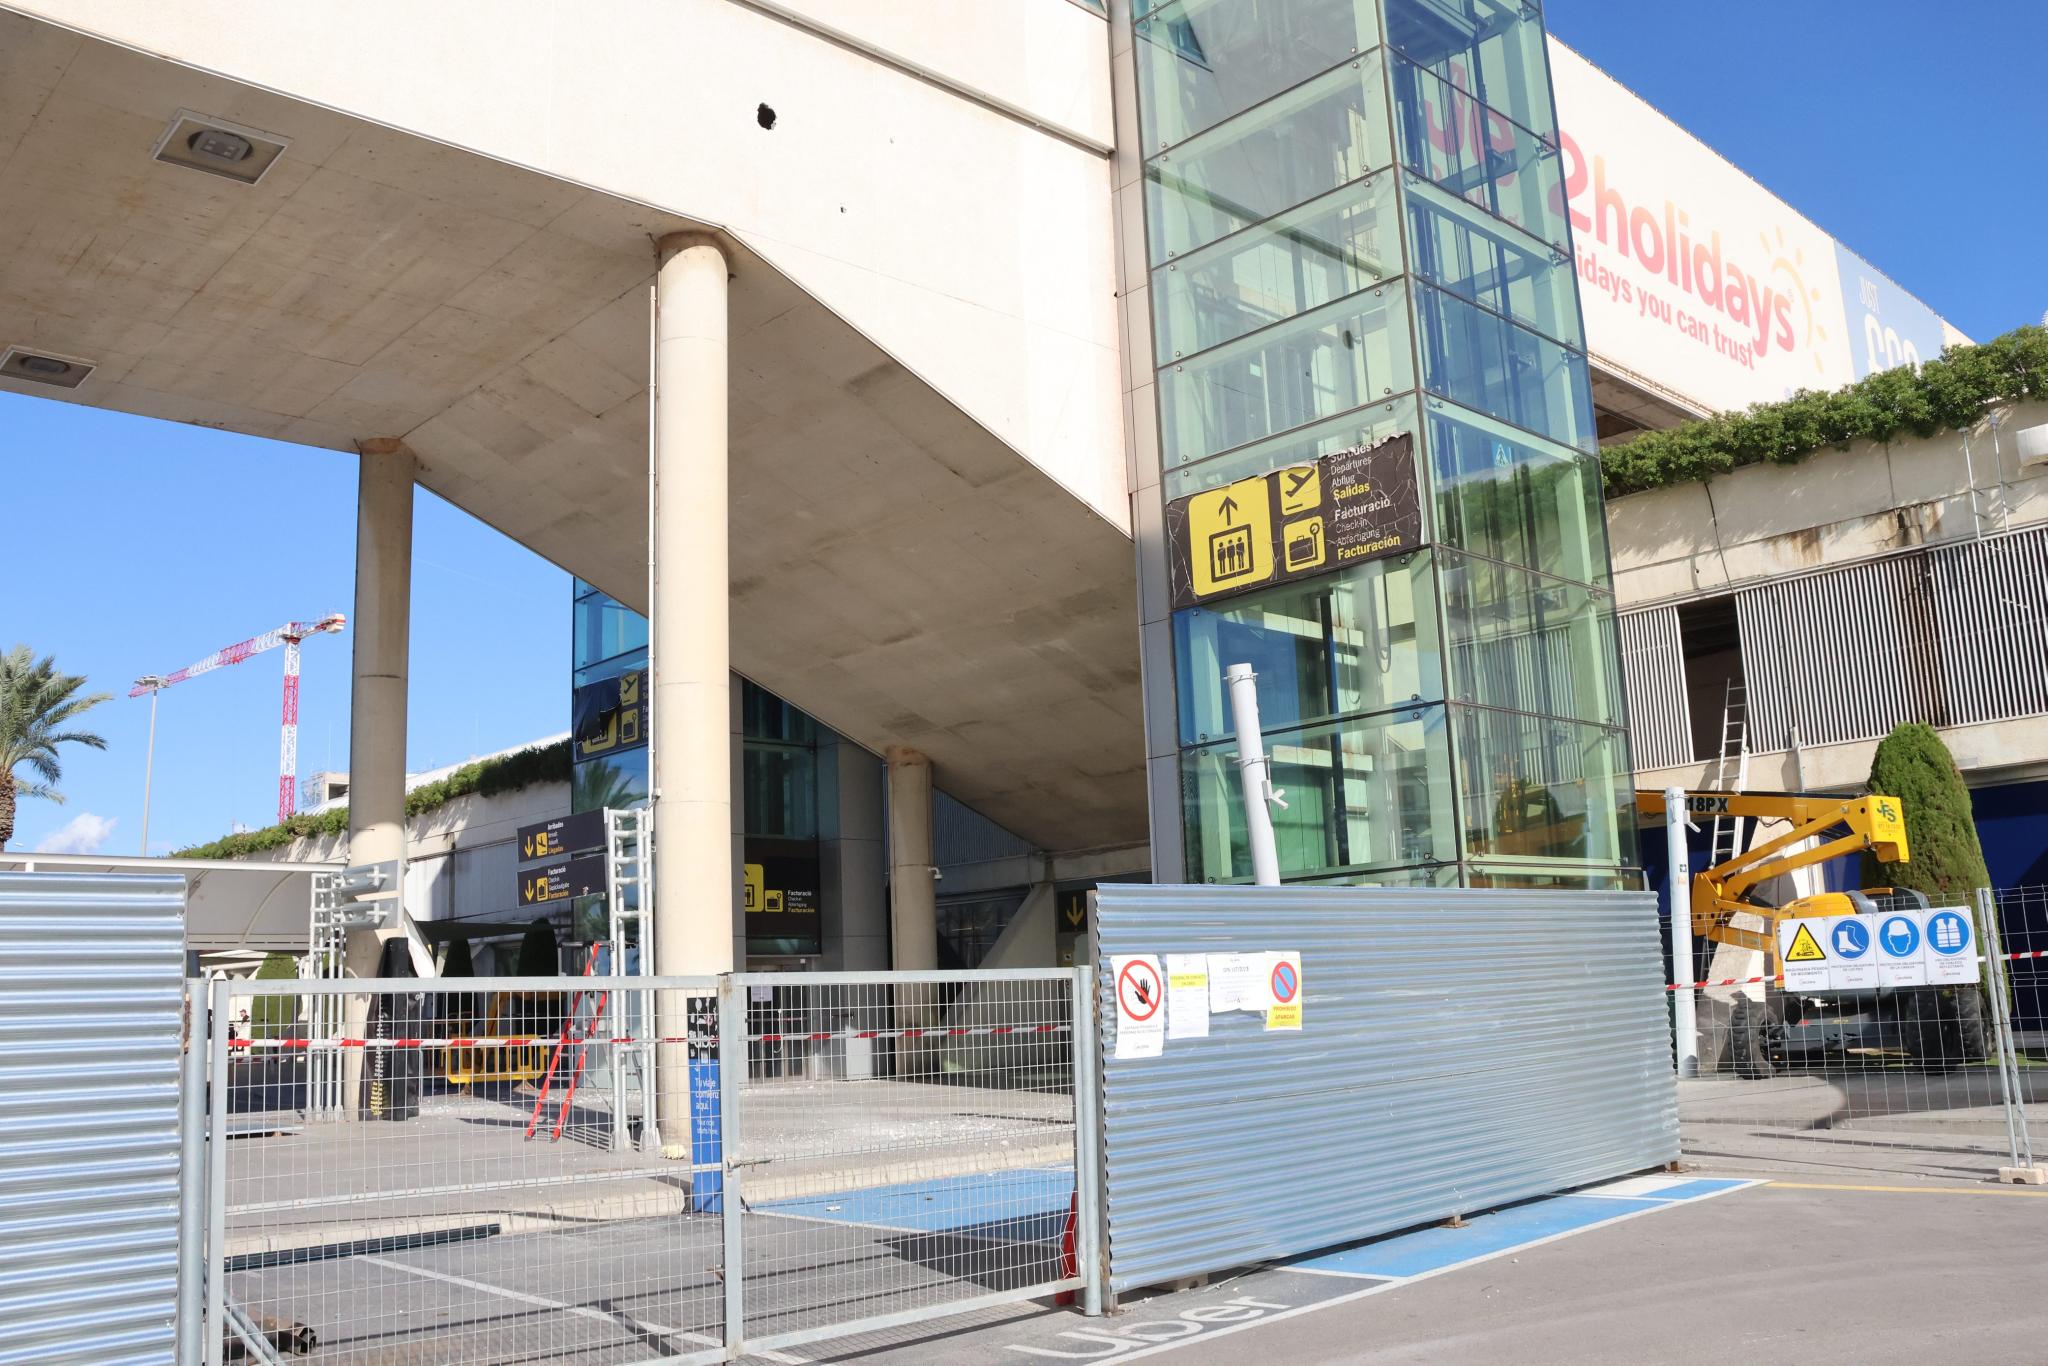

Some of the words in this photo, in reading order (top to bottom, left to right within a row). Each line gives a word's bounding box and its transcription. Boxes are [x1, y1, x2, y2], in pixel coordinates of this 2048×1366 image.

[1858, 275, 1880, 314] JUST
[1636, 286, 1672, 325] you
[1676, 306, 1709, 345] can
[1713, 322, 1755, 370] trust
[1330, 456, 1372, 476] Departures
[1332, 474, 1356, 488] Abflug
[1333, 481, 1370, 501] Salidas
[1335, 518, 1368, 534] Check-in
[1336, 526, 1381, 546] Abfertigung
[1337, 534, 1401, 560] Facturación
[1002, 1296, 1292, 1359] Uber
